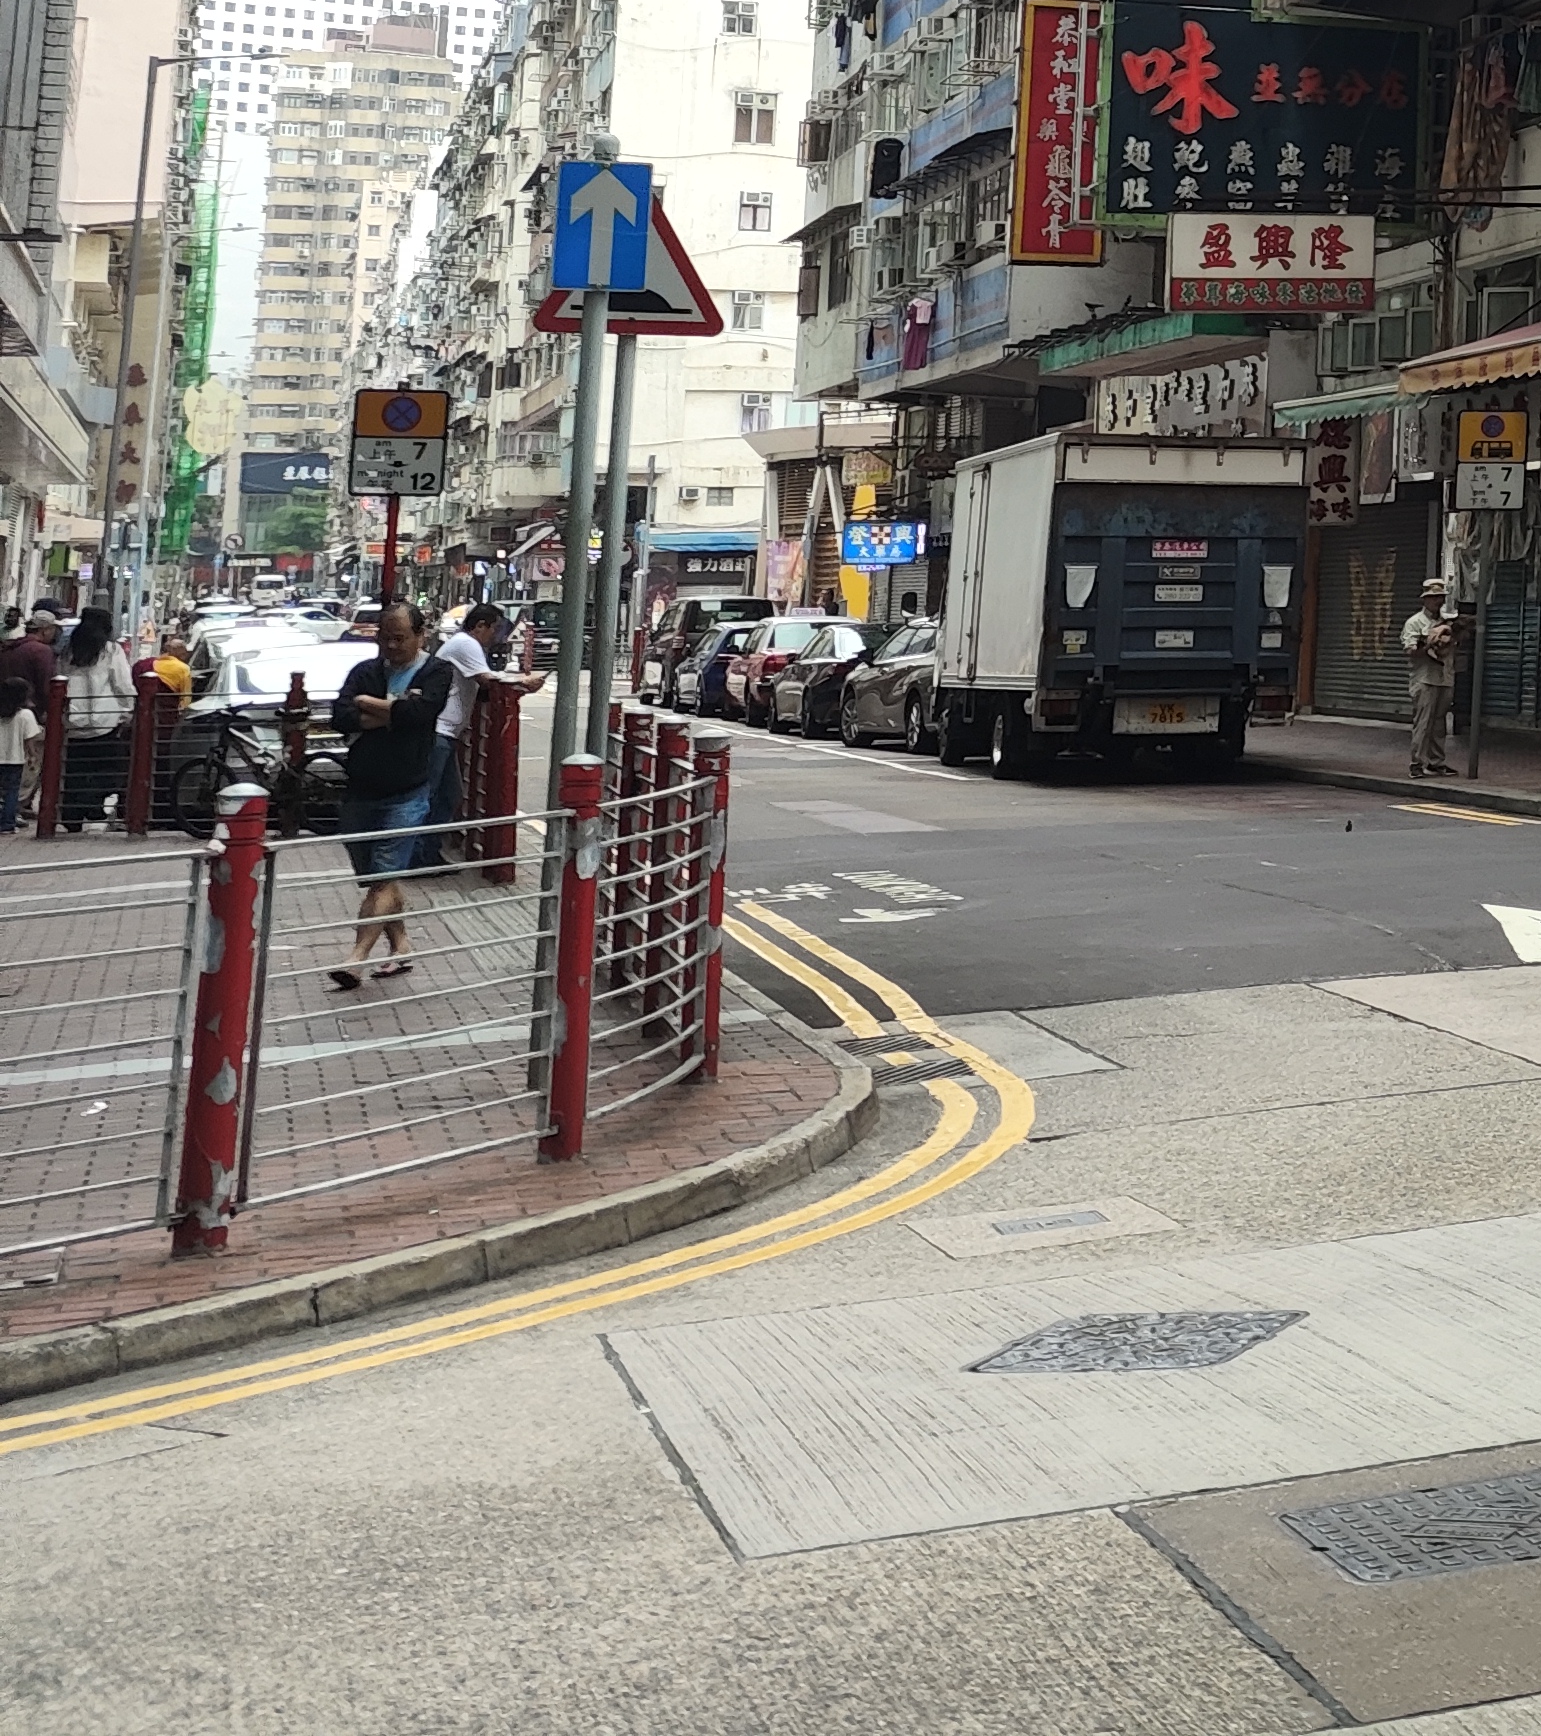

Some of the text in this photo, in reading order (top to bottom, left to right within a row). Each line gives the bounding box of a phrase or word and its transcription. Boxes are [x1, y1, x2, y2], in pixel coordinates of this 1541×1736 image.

[1199, 223, 1354, 271] 盈興隆
[368, 448, 396, 460] 上午
[412, 441, 428, 460] 7
[357, 469, 436, 491] mnight 12
[1500, 466, 1514, 482] 7
[1499, 491, 1512, 506] 7
